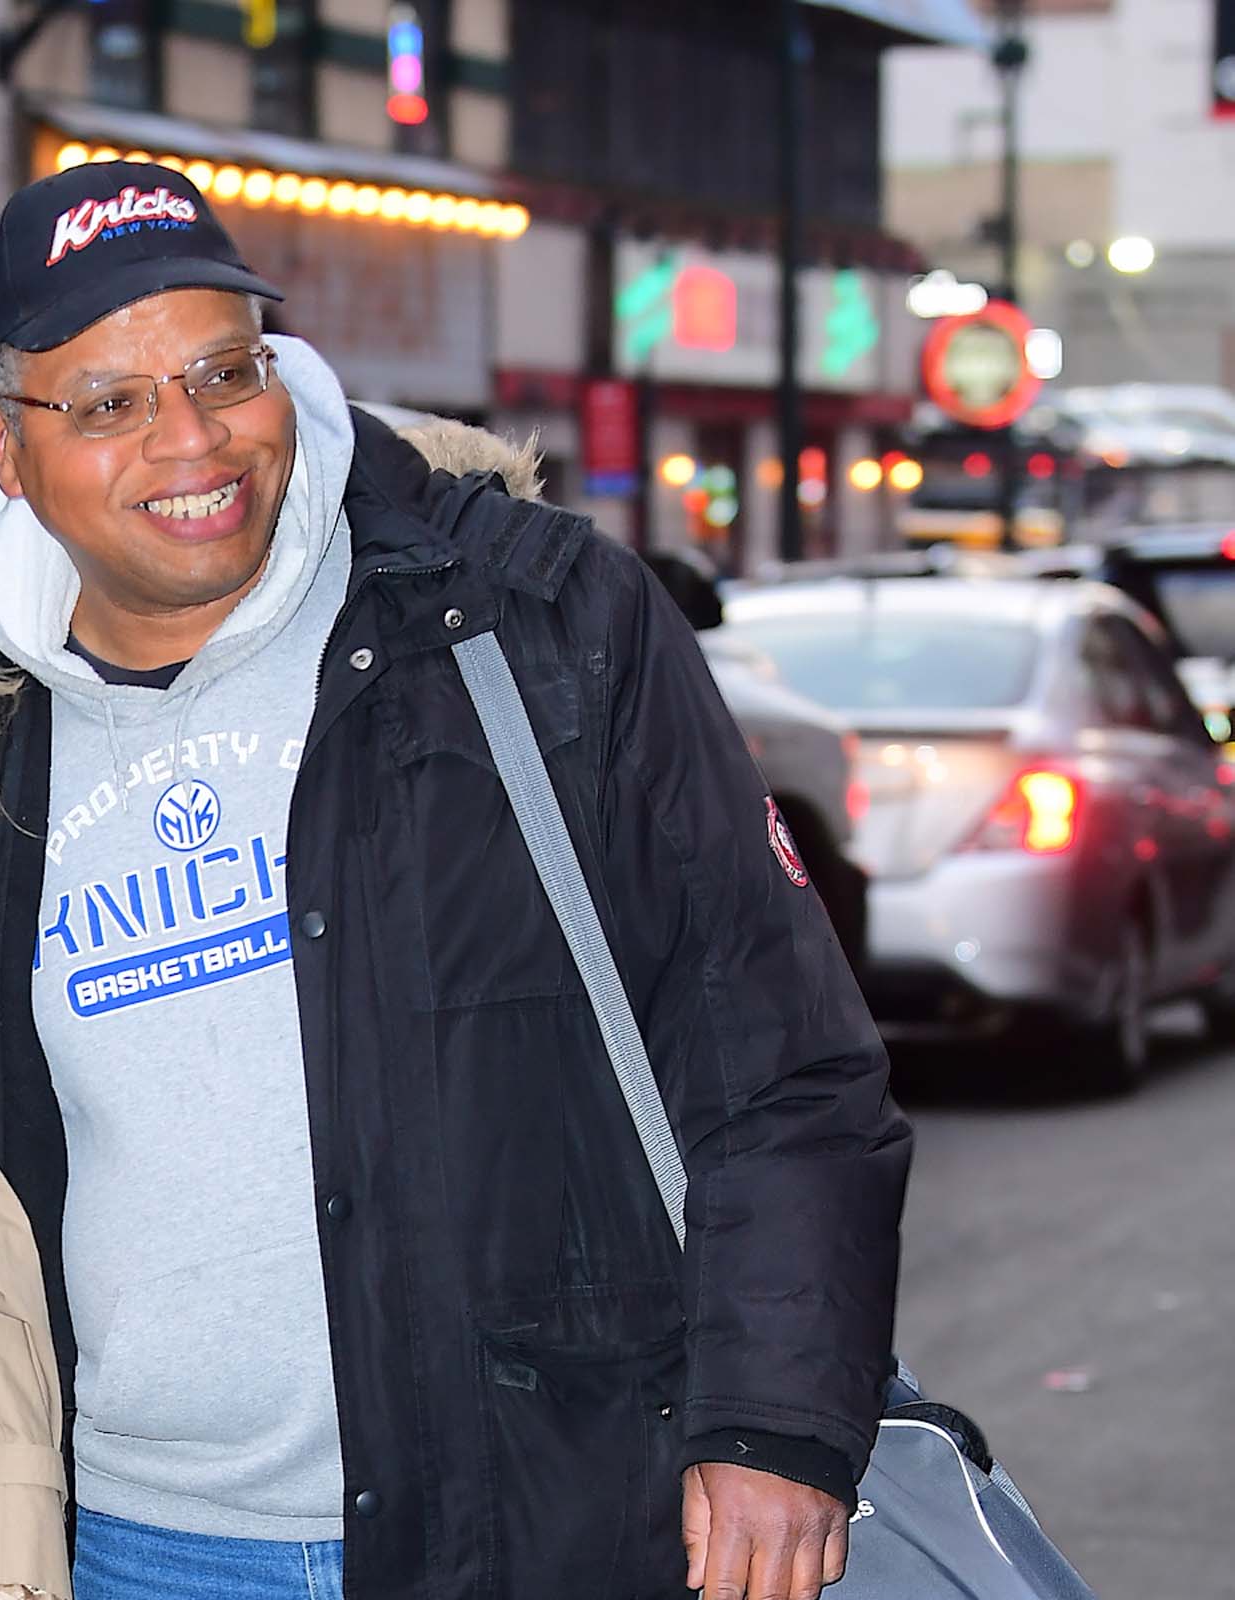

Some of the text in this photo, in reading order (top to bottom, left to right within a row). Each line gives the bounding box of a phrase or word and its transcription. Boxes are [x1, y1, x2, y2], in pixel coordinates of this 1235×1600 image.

[46, 184, 197, 267] Knicks
[101, 219, 191, 241] NEW YORK
[45, 731, 260, 866] PROPERTY
[74, 930, 288, 1008] BASKETBALL
